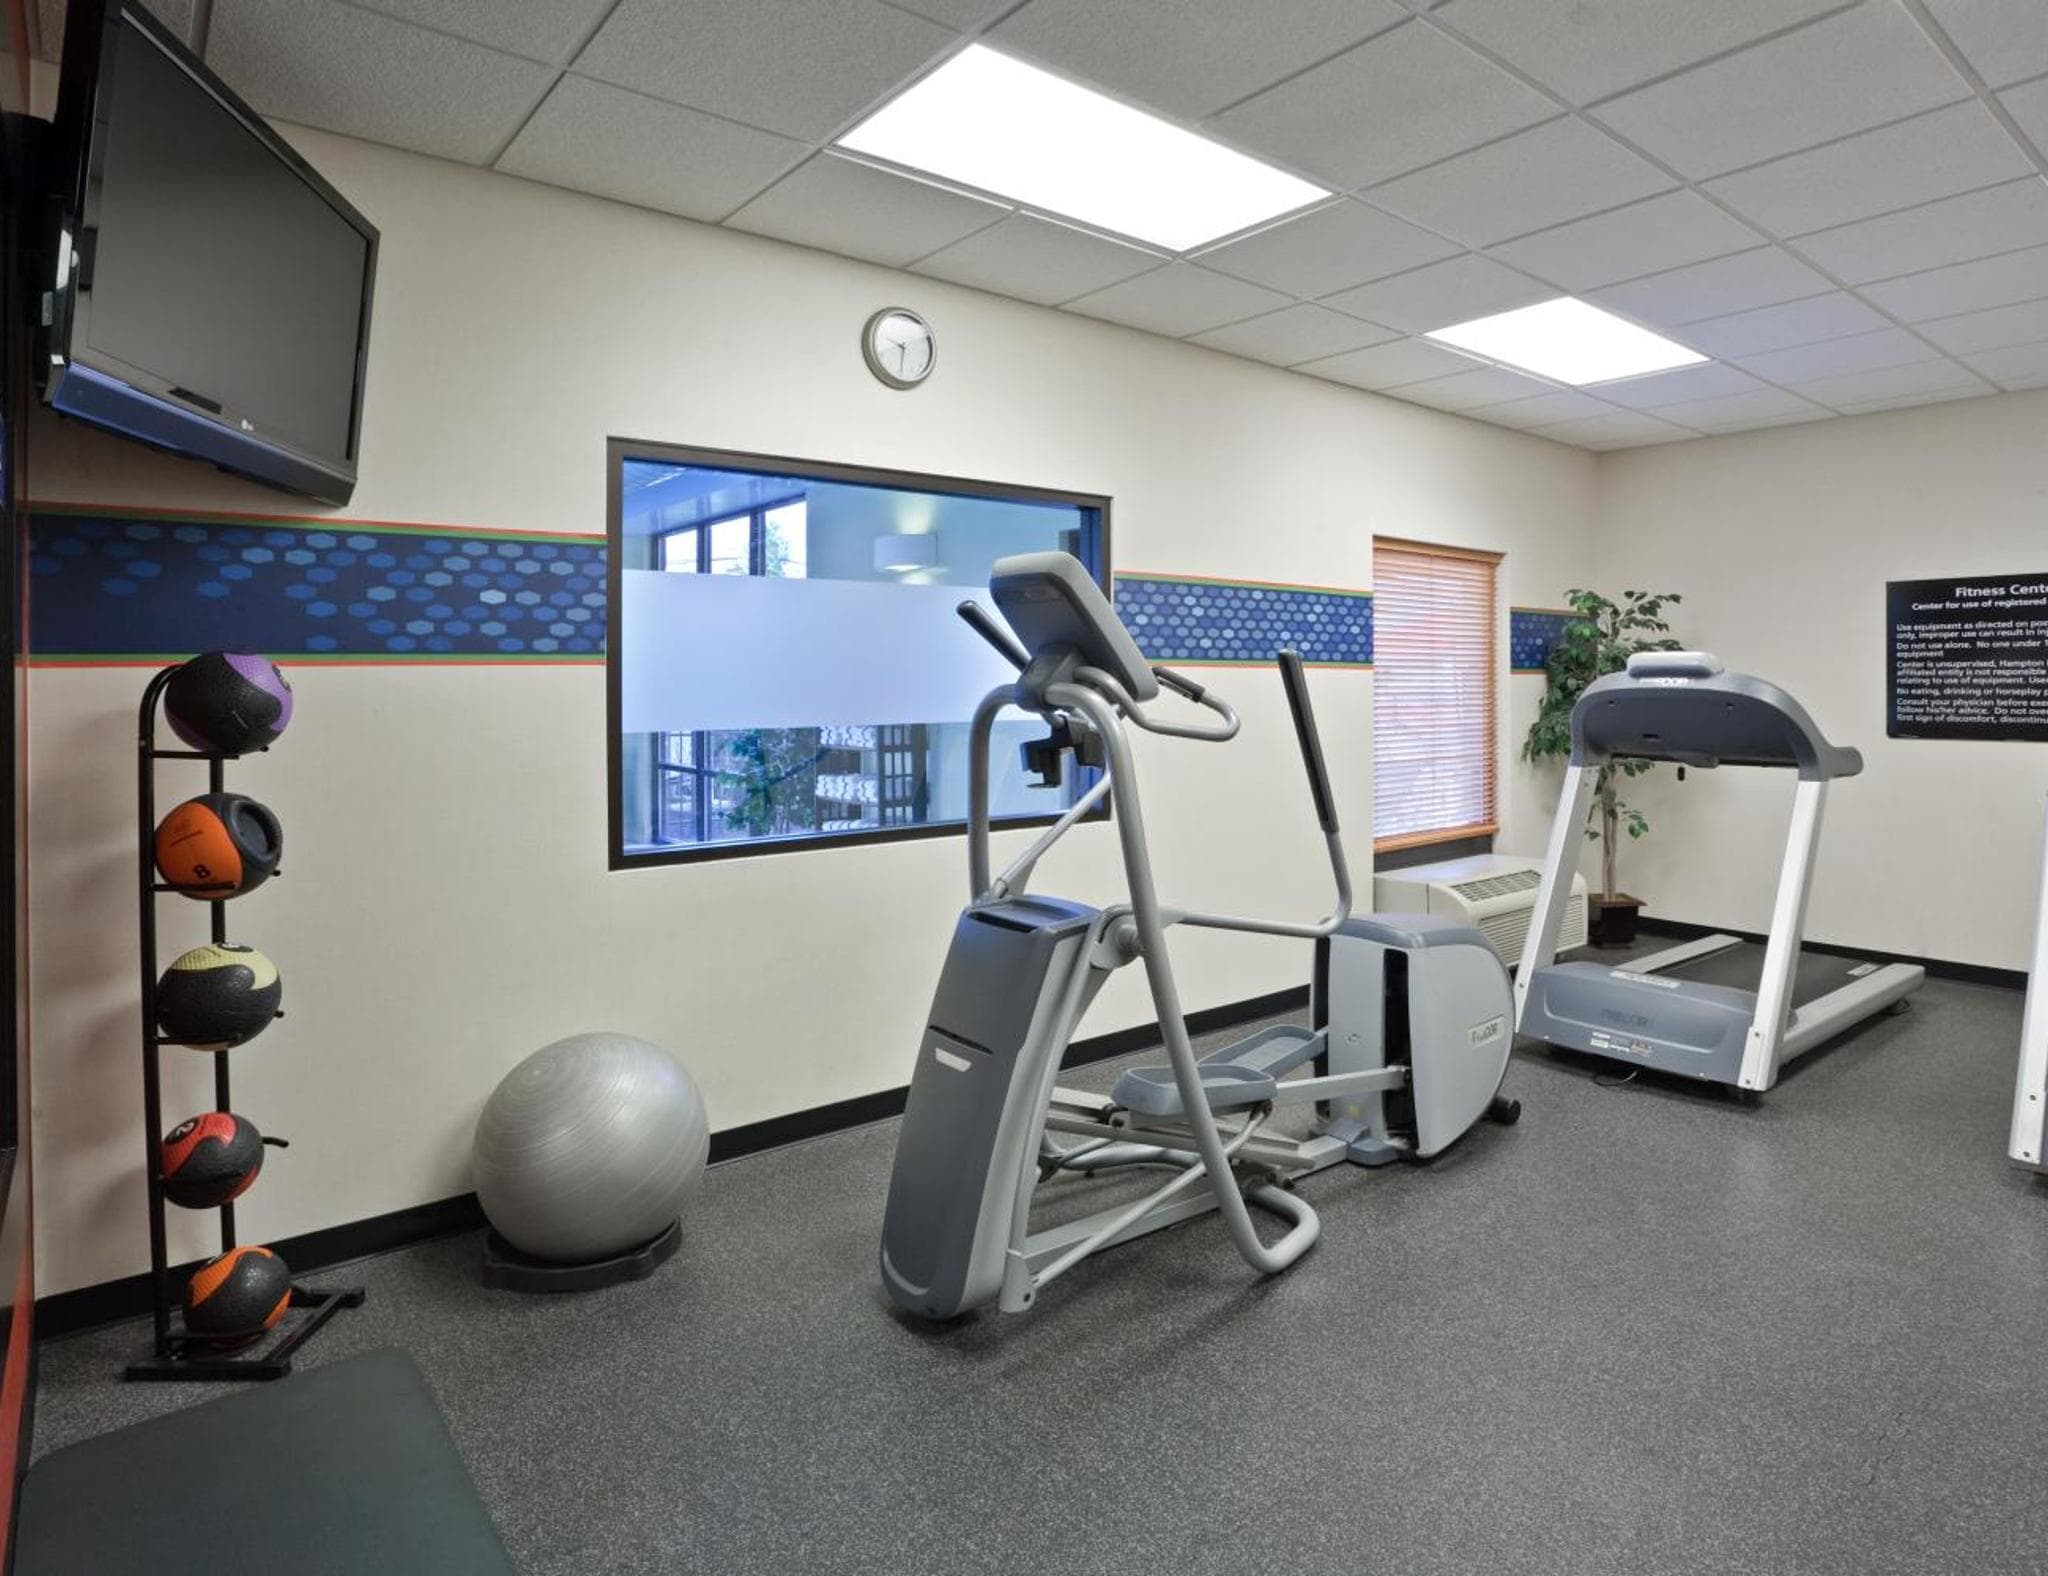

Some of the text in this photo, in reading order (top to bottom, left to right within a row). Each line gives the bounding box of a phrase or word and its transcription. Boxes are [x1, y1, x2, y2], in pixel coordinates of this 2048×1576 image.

[1955, 586, 2006, 598] Fitness
[1912, 602, 1943, 611] Center
[1945, 600, 1960, 609] for
[1981, 599, 1992, 608] of
[1994, 597, 2047, 608] registered
[1896, 623, 1911, 631] Use
[1913, 622, 1962, 631] equipment
[1963, 622, 1973, 630] as
[1975, 620, 2013, 629] directed
[1962, 630, 1977, 638] use
[1996, 628, 2024, 637] result
[1896, 642, 1909, 650] Do
[2012, 639, 2041, 647] under
[1896, 660, 1925, 668] Center
[1974, 668, 1990, 676] not
[1993, 667, 2047, 677] responsible
[1960, 676, 1970, 684] of
[1943, 687, 1982, 697] drinking
[1995, 687, 2042, 697] horseplay
[1996, 698, 2029, 707] before
[1994, 706, 2008, 715] Do
[193, 864, 211, 878] 8
